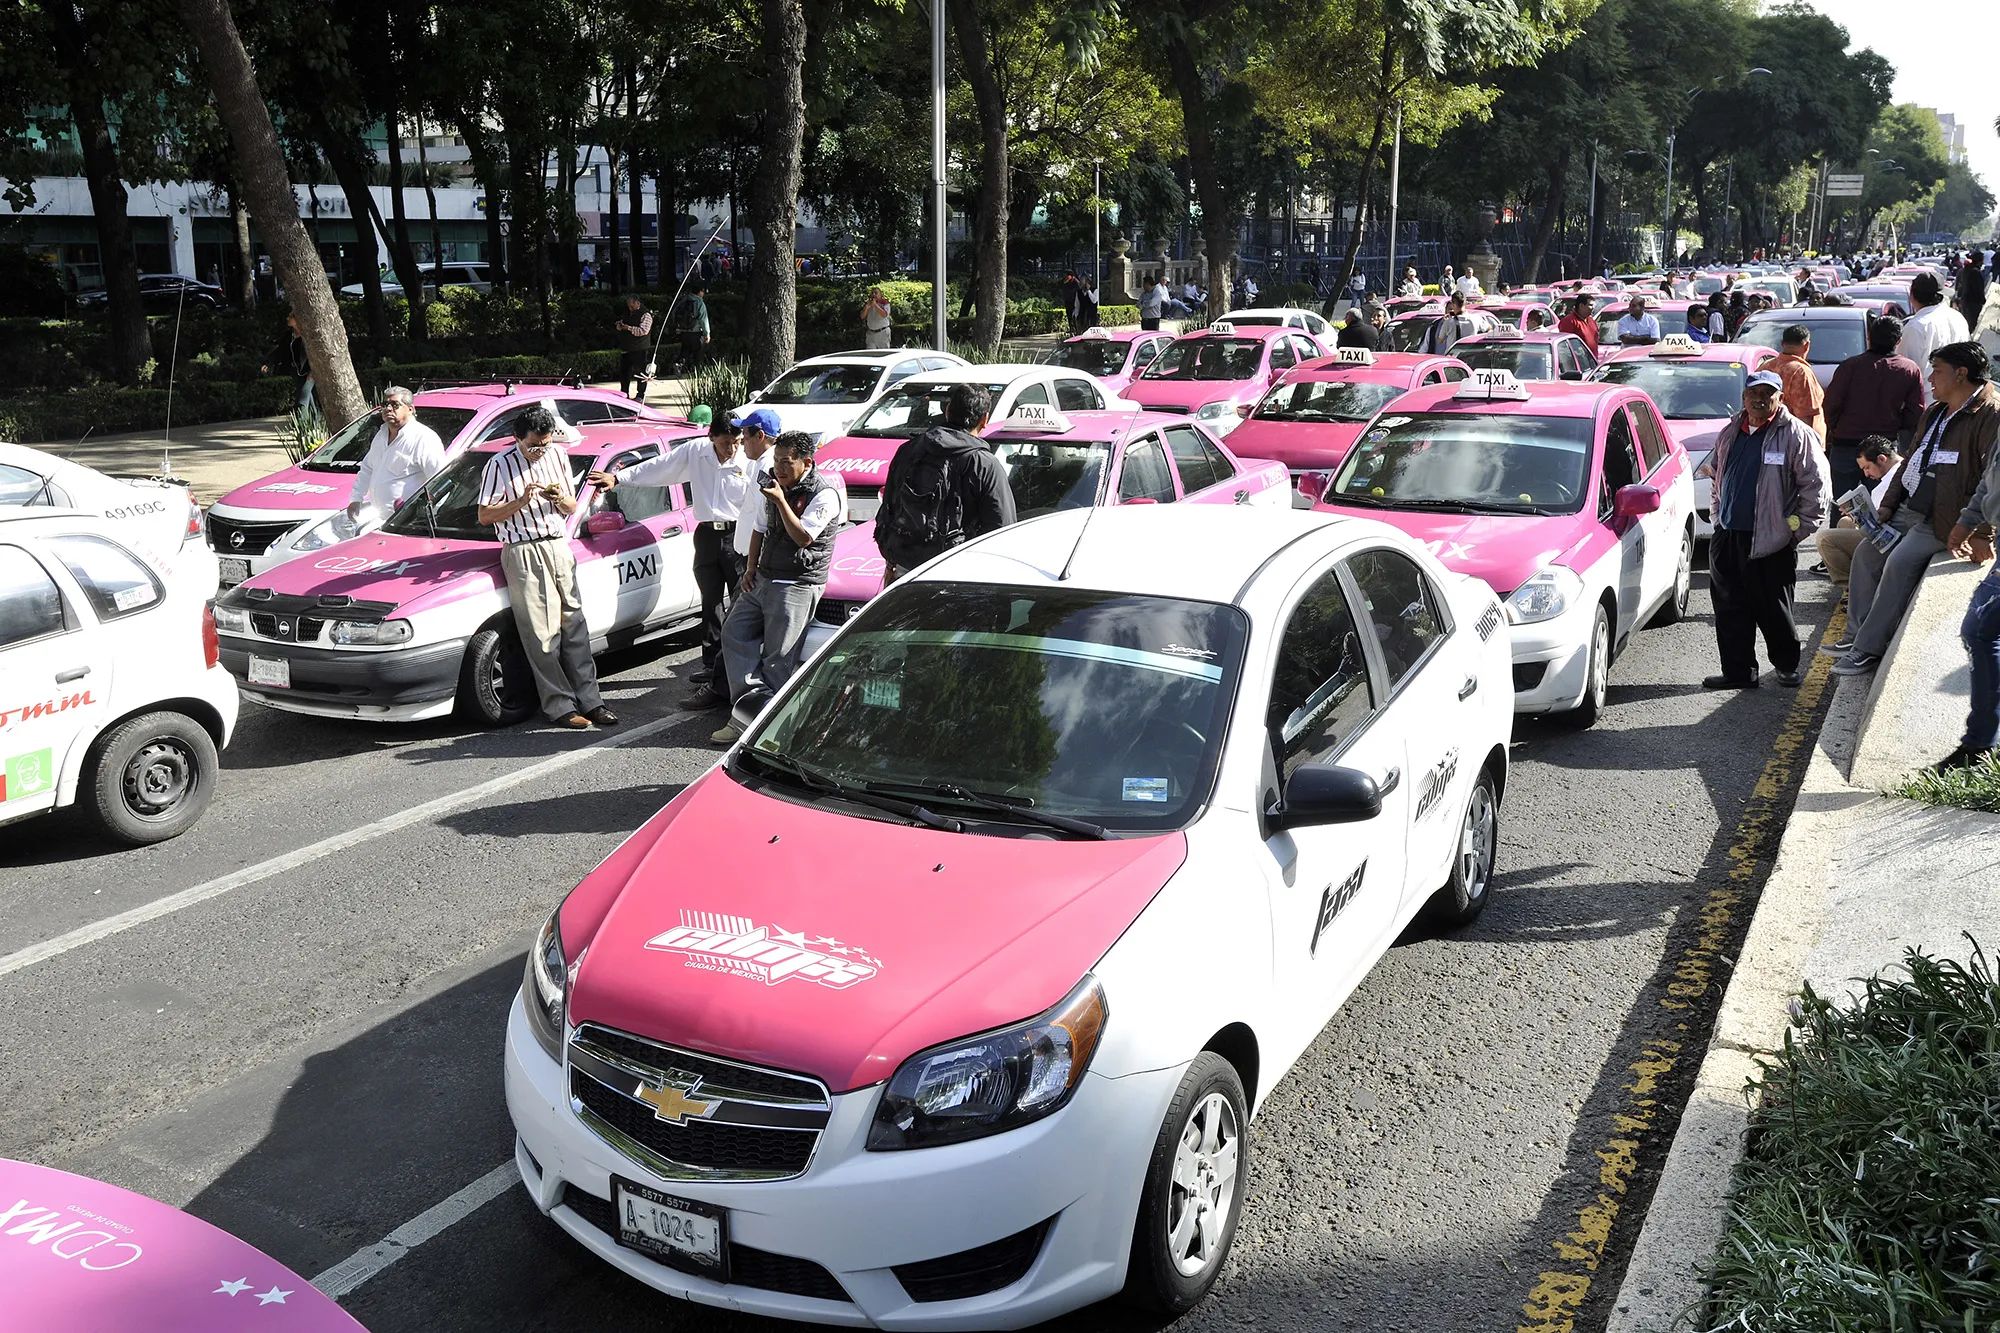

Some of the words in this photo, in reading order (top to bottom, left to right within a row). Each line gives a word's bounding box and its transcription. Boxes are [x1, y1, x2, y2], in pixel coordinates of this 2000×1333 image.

[1665, 337, 1687, 346] TAXI
[1340, 351, 1365, 361] TAXI
[1476, 373, 1505, 385] TAXI
[1017, 407, 1046, 419] TAXI
[313, 556, 424, 576] CDMX
[612, 553, 657, 585] TAXI
[833, 556, 886, 572] CD
[684, 960, 717, 972] CIUDAD
[716, 965, 731, 975] DE
[641, 1188, 664, 1203] 5577
[666, 1196, 691, 1211] 5577
[0, 1198, 143, 1271] CDMX
